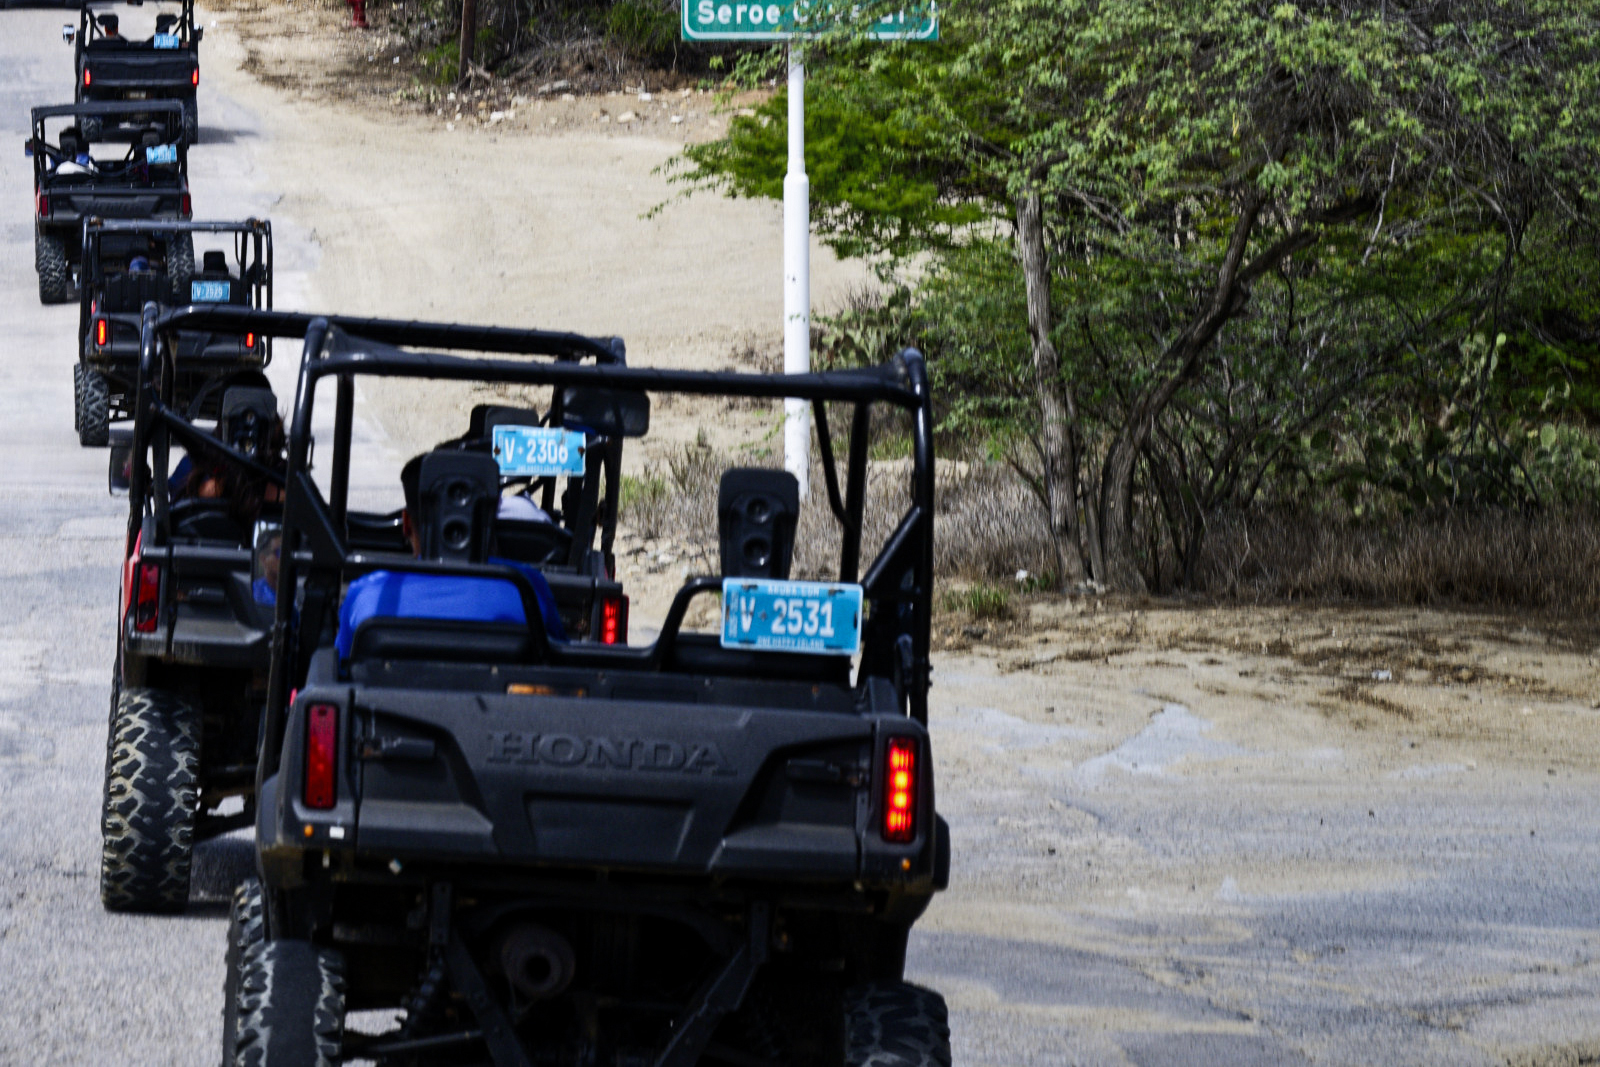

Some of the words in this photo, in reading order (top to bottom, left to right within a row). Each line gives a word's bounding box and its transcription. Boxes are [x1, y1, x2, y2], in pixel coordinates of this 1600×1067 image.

[697, 0, 781, 26] Seroe
[504, 437, 516, 464] V
[740, 596, 756, 633] V
[771, 598, 835, 638] 2531
[486, 733, 738, 777] HONDA
